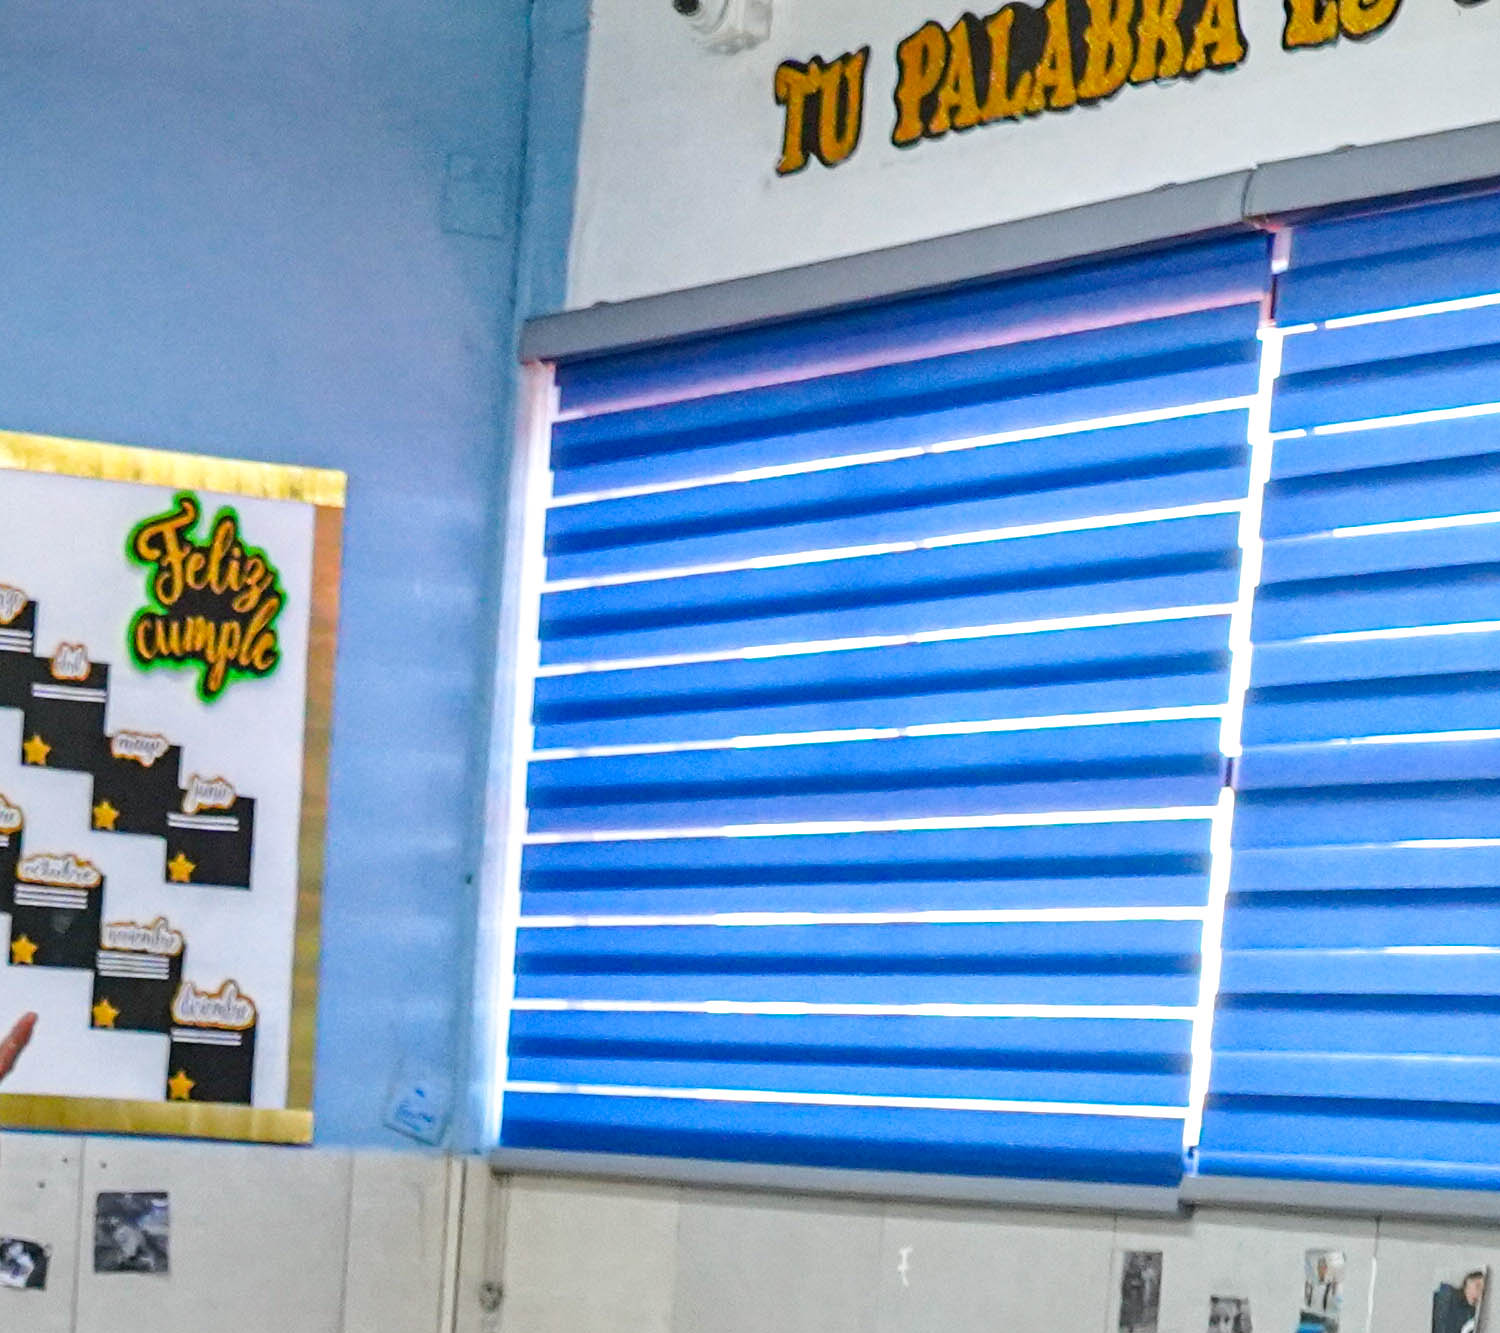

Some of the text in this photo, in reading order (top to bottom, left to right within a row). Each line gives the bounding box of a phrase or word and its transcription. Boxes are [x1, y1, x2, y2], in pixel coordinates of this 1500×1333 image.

[775, 46, 869, 175] TU
[892, 0, 1249, 148] PALABRA
[137, 499, 273, 613] Feliz
[136, 597, 280, 692] cumple
